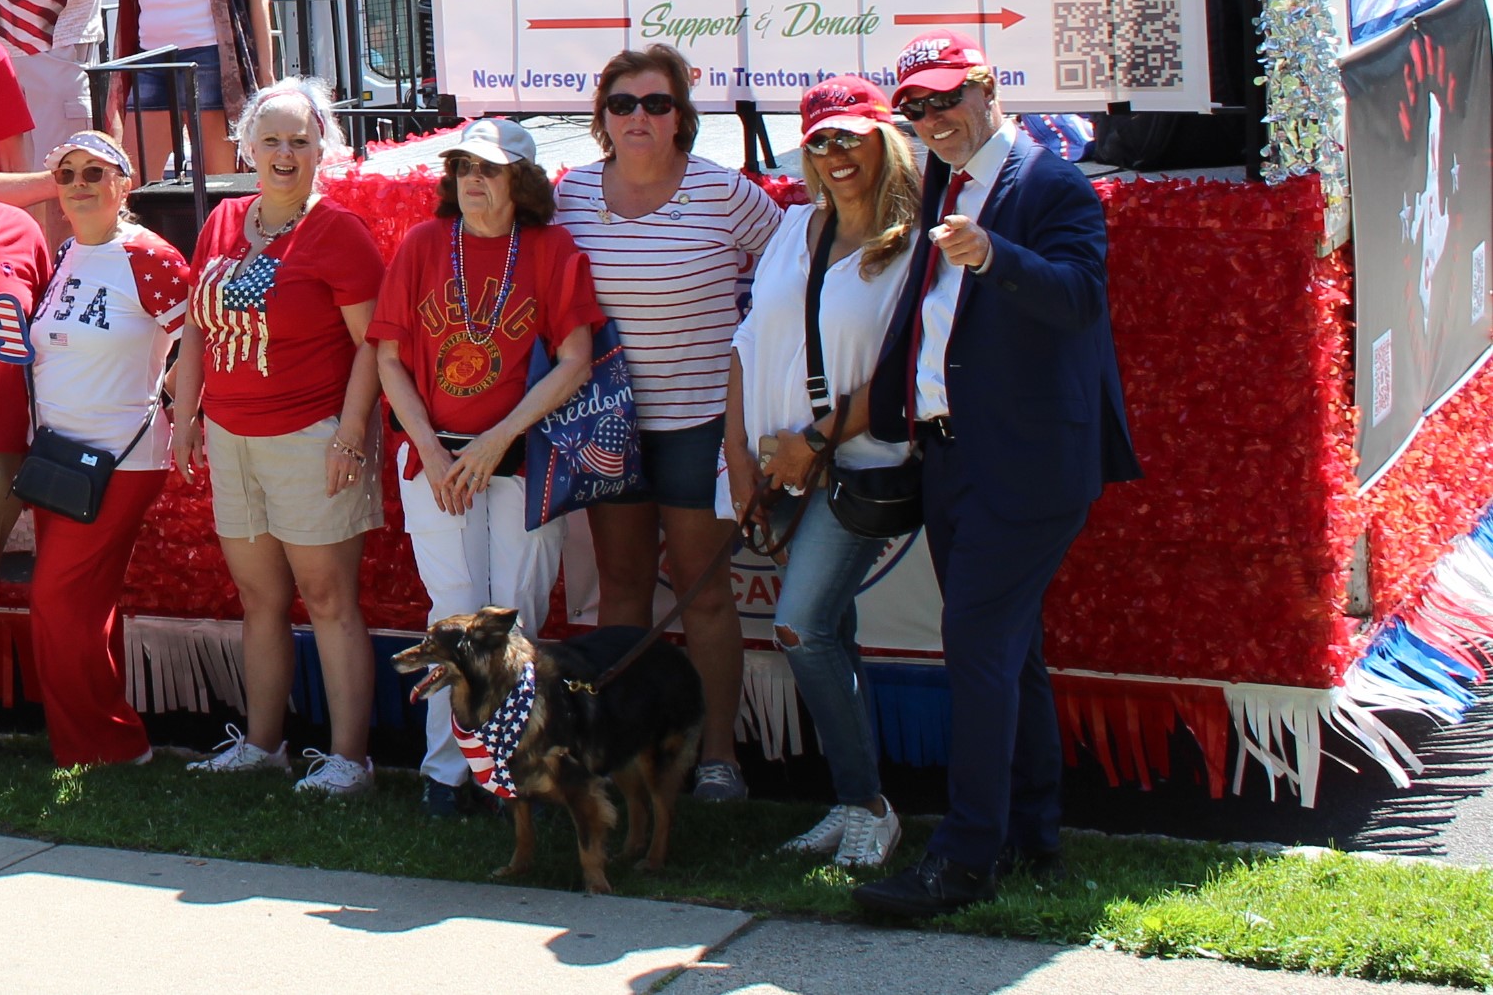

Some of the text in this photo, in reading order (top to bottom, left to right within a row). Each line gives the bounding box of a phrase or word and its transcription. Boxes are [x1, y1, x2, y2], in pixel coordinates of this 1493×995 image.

[641, 1, 750, 45] Support
[782, 2, 880, 37] Donate
[900, 50, 940, 74] 2028
[473, 69, 514, 88] New
[521, 69, 587, 92] Jersey
[710, 68, 727, 86] in
[733, 67, 809, 87] Trenton
[817, 67, 838, 81] to
[994, 67, 1025, 86] lan
[417, 276, 538, 340] USMC
[471, 332, 499, 358] STTES
[468, 371, 498, 395] CORPS
[541, 384, 634, 434] Freedom
[586, 479, 626, 503] Ring
